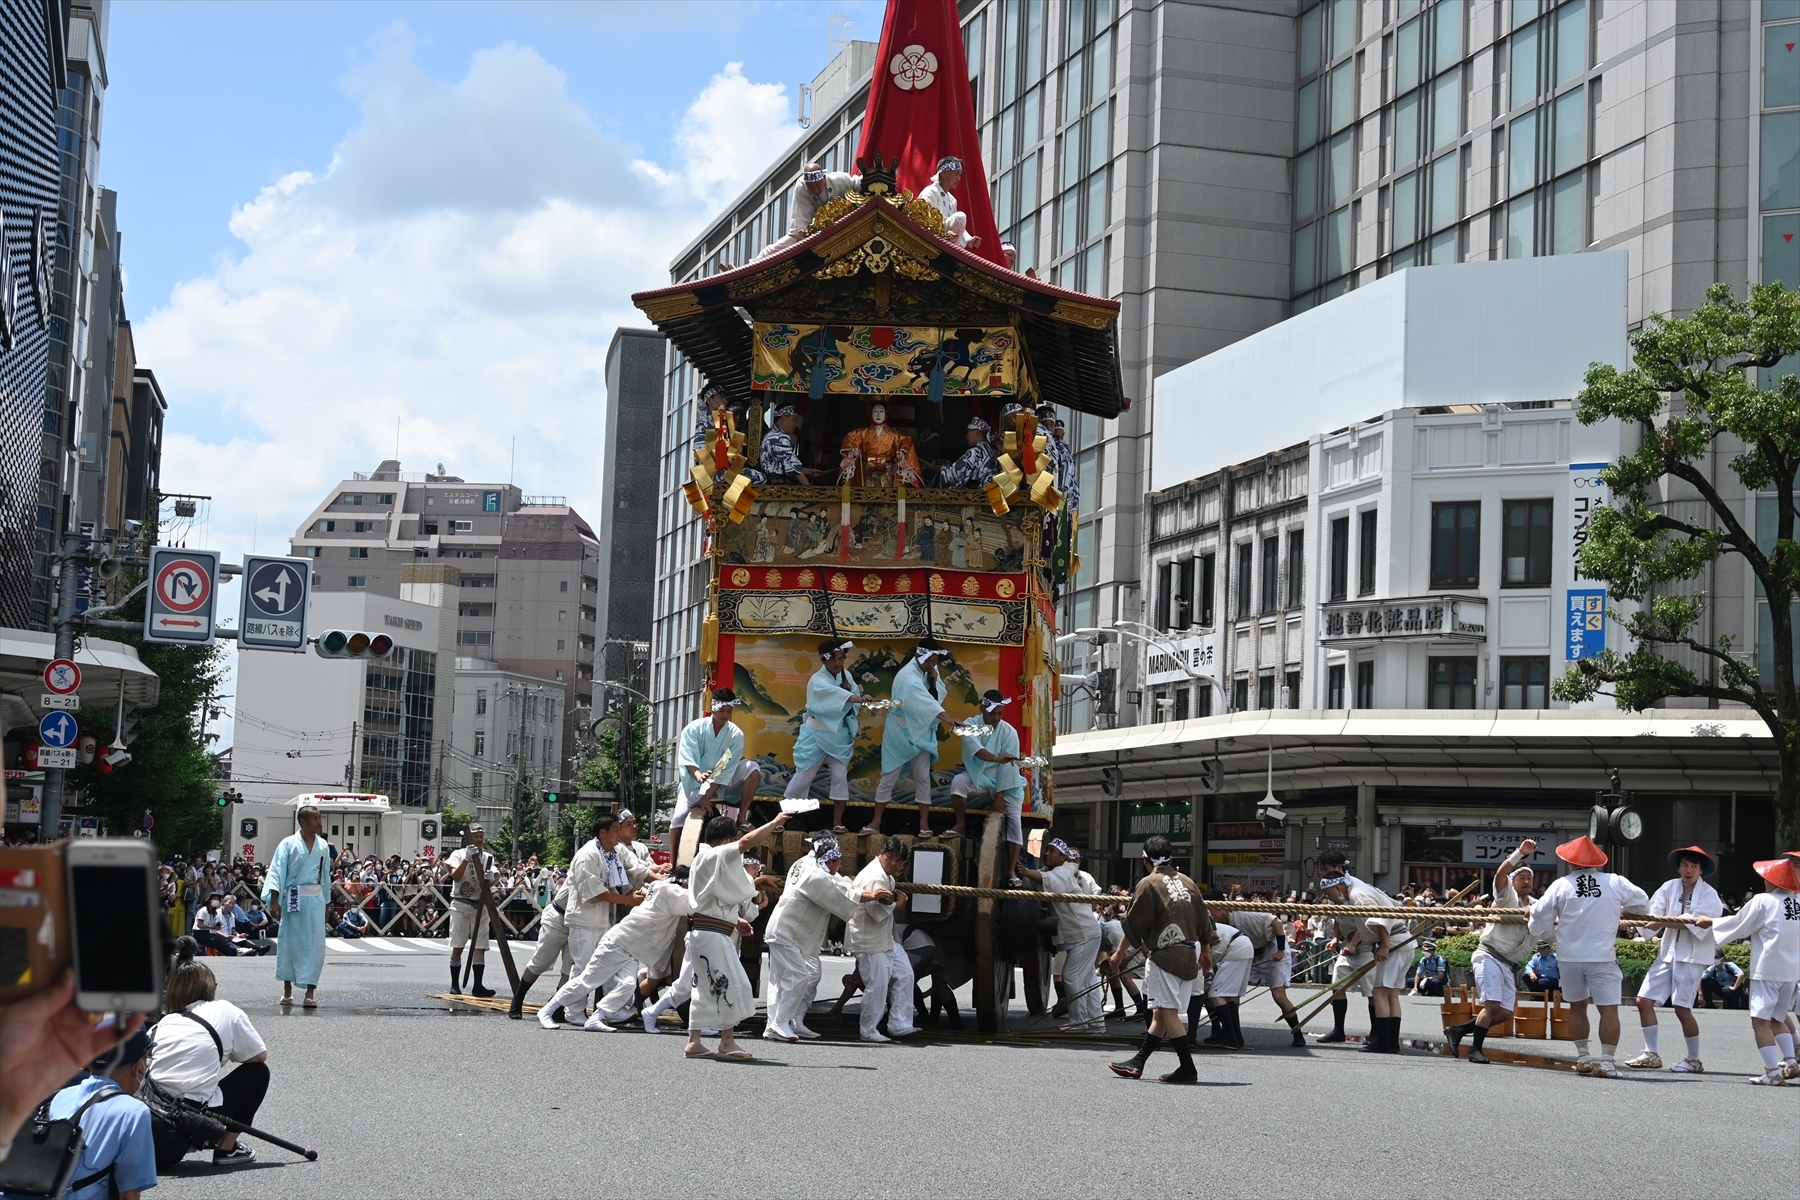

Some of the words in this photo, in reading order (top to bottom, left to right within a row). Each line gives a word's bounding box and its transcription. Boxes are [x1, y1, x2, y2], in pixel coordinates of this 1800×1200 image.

[1326, 606, 1444, 636] 池善化粧品店
[1587, 597, 1601, 629] すぐ
[246, 623, 300, 638] 路線バスを除く
[1570, 595, 1585, 659] 買えます
[1148, 649, 1189, 675] MARUMARU
[1193, 645, 1214, 667] 雲の茶
[39, 749, 75, 757] 路線バスを除く
[1131, 814, 1170, 834] MARUMARU
[1217, 825, 1268, 837] アクセスチケット
[1259, 839, 1273, 848] ACCESS
[1222, 853, 1237, 864] Money
